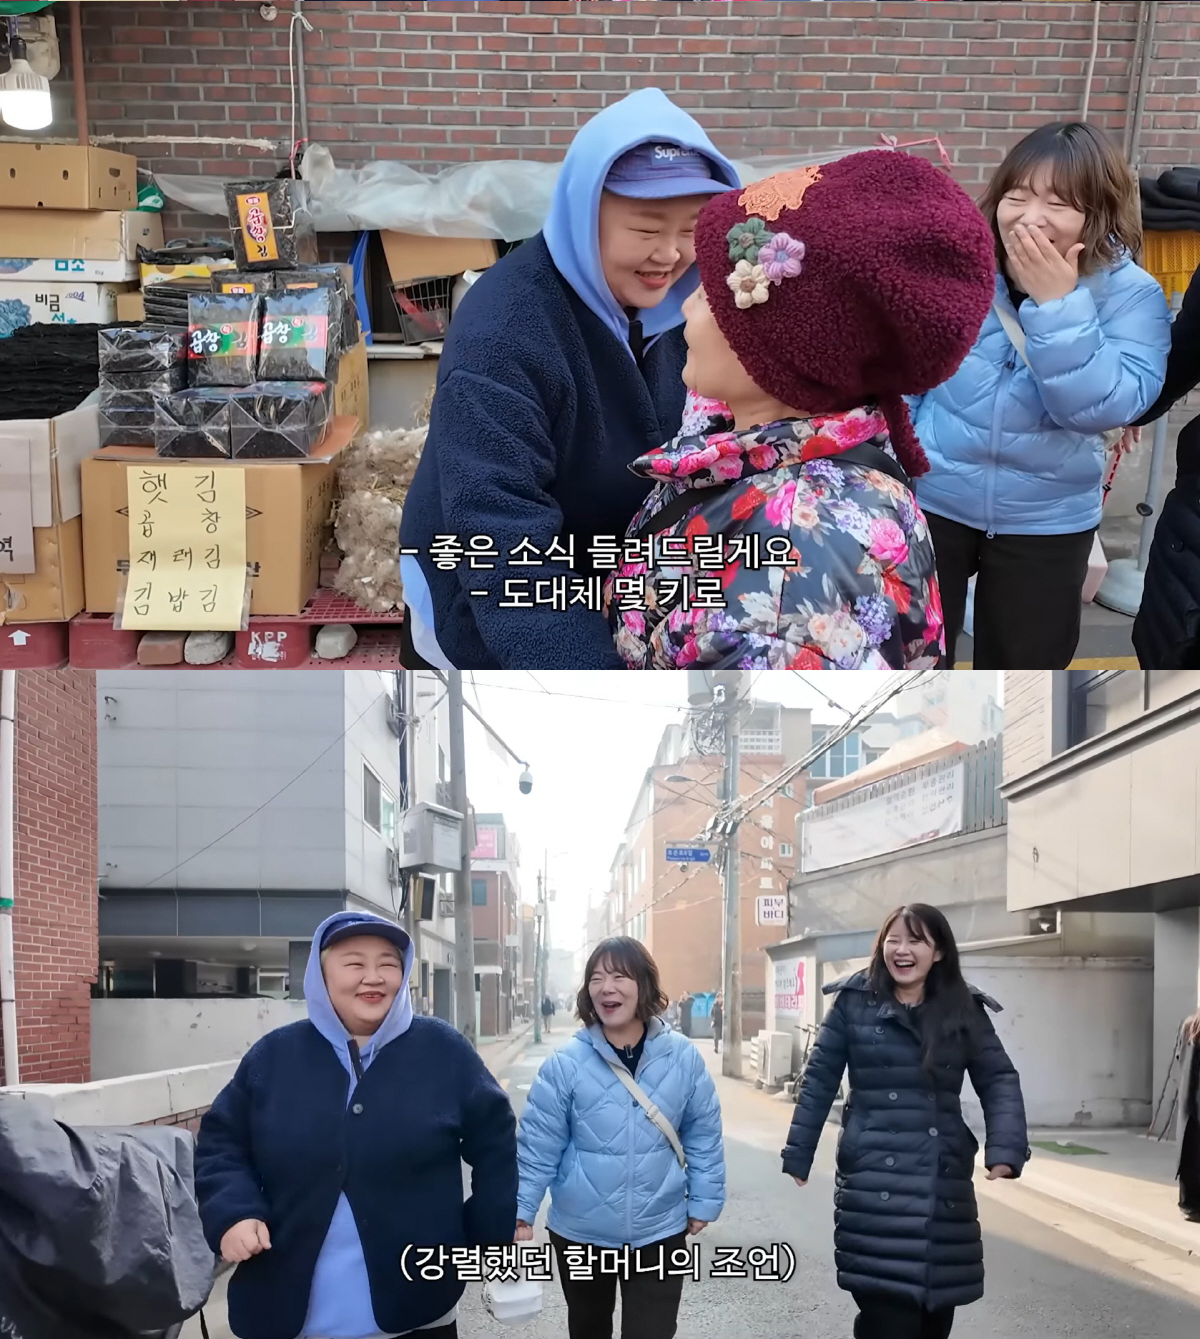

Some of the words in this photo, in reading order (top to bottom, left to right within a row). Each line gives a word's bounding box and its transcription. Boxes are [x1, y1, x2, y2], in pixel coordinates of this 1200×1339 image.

[654, 145, 700, 161] Suprem
[35, 292, 60, 312] 비금
[190, 329, 221, 354] 곱창
[261, 321, 292, 344] 곱창
[763, 898, 784, 907] 피부
[763, 910, 784, 919] 바디
